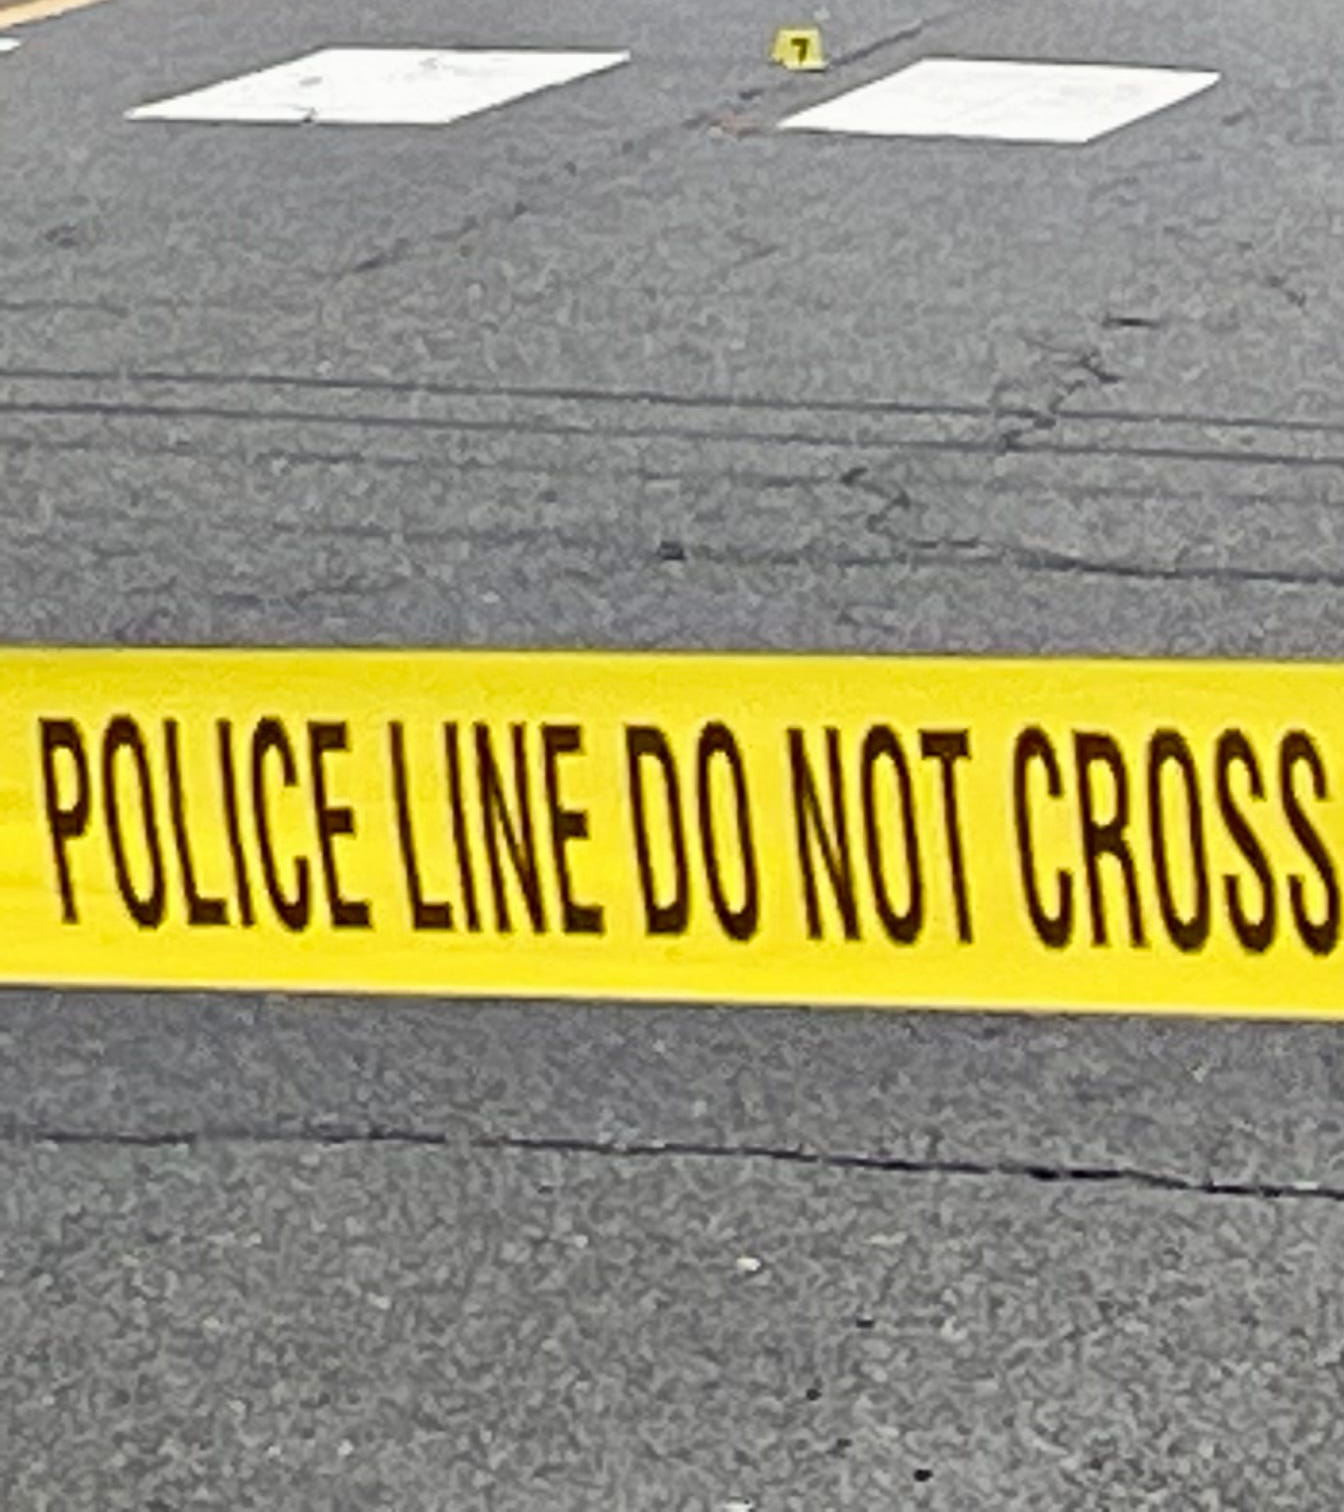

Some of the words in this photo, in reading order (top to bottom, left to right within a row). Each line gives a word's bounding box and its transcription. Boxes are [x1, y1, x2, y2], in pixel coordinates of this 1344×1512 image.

[790, 37, 810, 65] 7
[38, 716, 371, 934] POLICE
[389, 722, 604, 935] LINE
[625, 723, 759, 942] DO
[787, 728, 972, 945] NOT
[1013, 728, 1341, 956] CROSS
